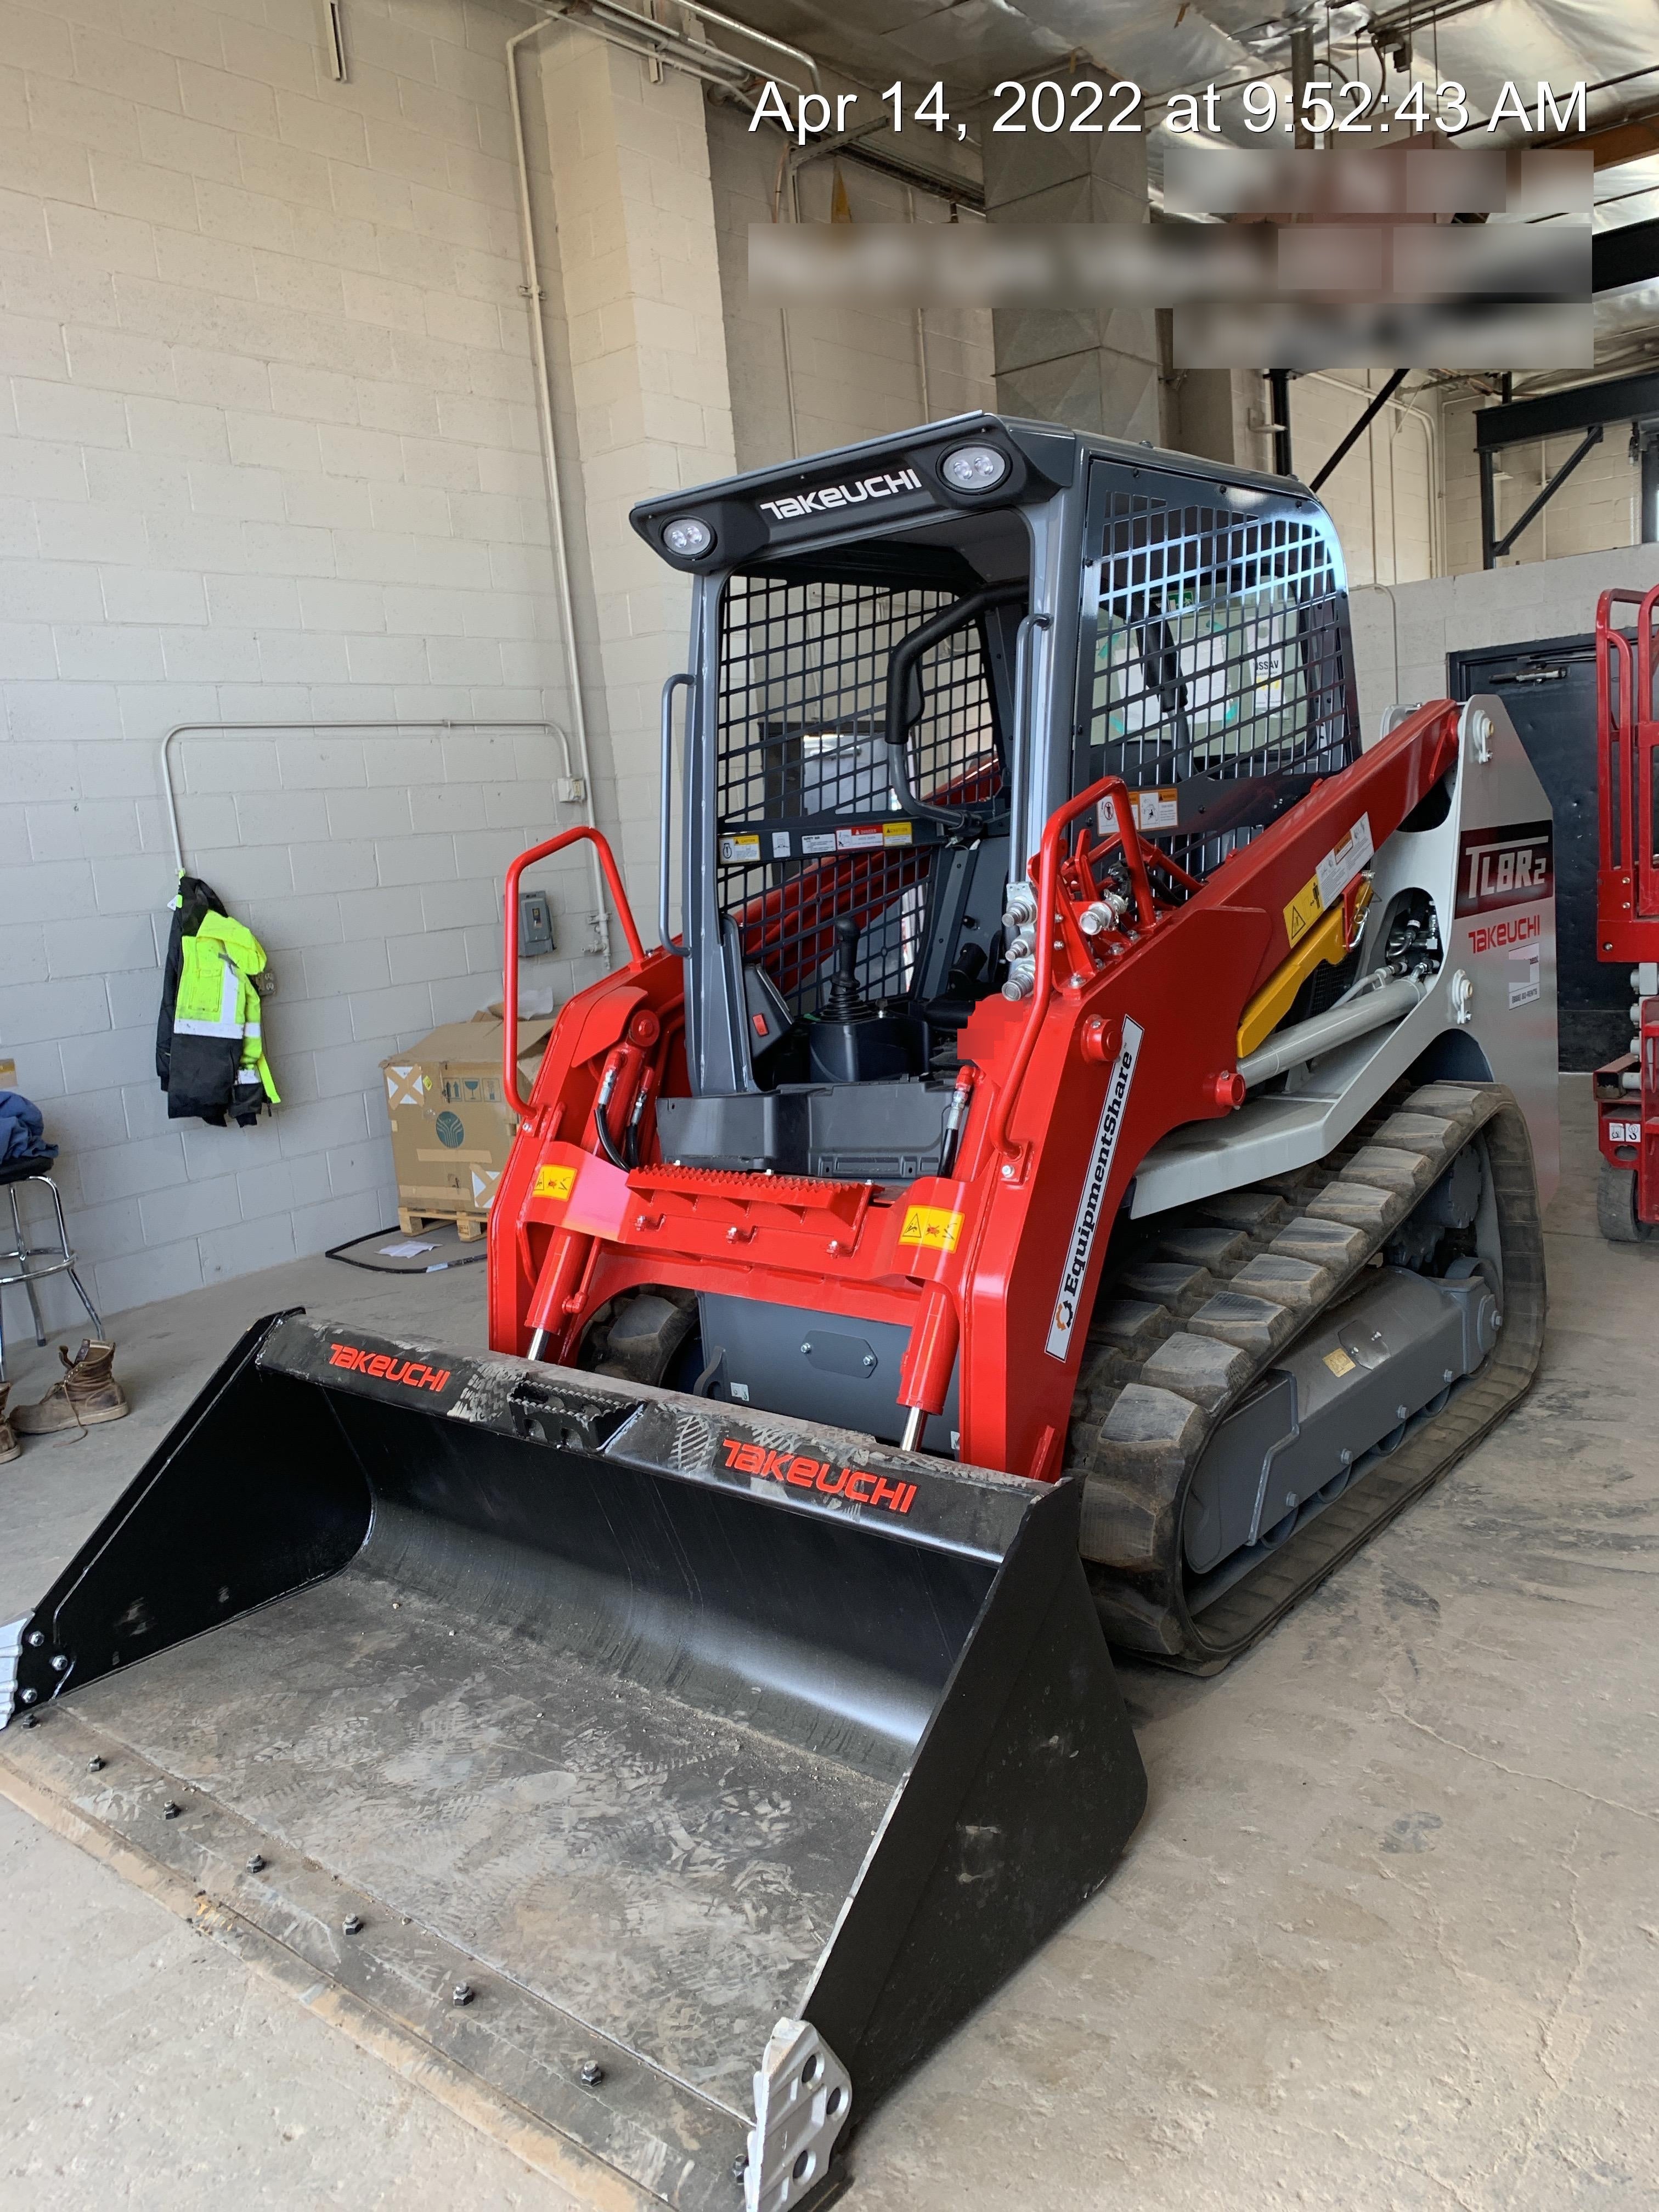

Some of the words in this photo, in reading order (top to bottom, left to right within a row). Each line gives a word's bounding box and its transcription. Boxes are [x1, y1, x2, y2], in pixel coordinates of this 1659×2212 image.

[760, 469, 922, 520] TAKEUCHI
[1465, 836, 1549, 899] TL8R2
[1469, 915, 1540, 953] TAKEUCHI
[1064, 1051, 1132, 1297] EquipmentShare
[330, 1344, 450, 1392] TAKEUCHI
[723, 1438, 918, 1513] TAKEUCHI
